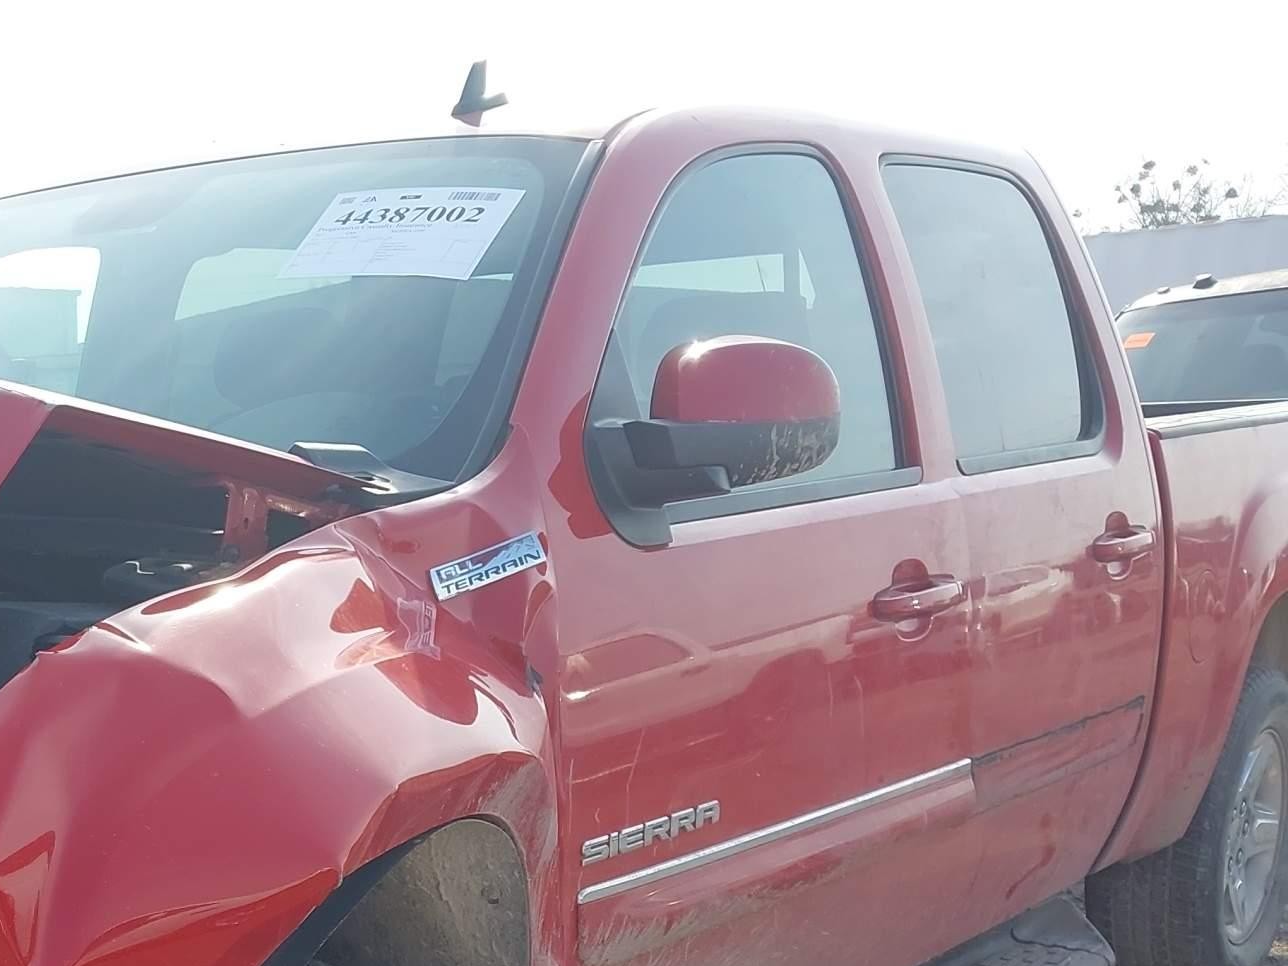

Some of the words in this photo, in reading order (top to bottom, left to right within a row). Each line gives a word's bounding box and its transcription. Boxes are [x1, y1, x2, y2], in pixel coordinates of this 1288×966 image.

[334, 206, 486, 225] 44387002
[438, 559, 483, 580] ALL
[441, 550, 541, 594] TERRAIN
[581, 800, 721, 867] SIERRA
